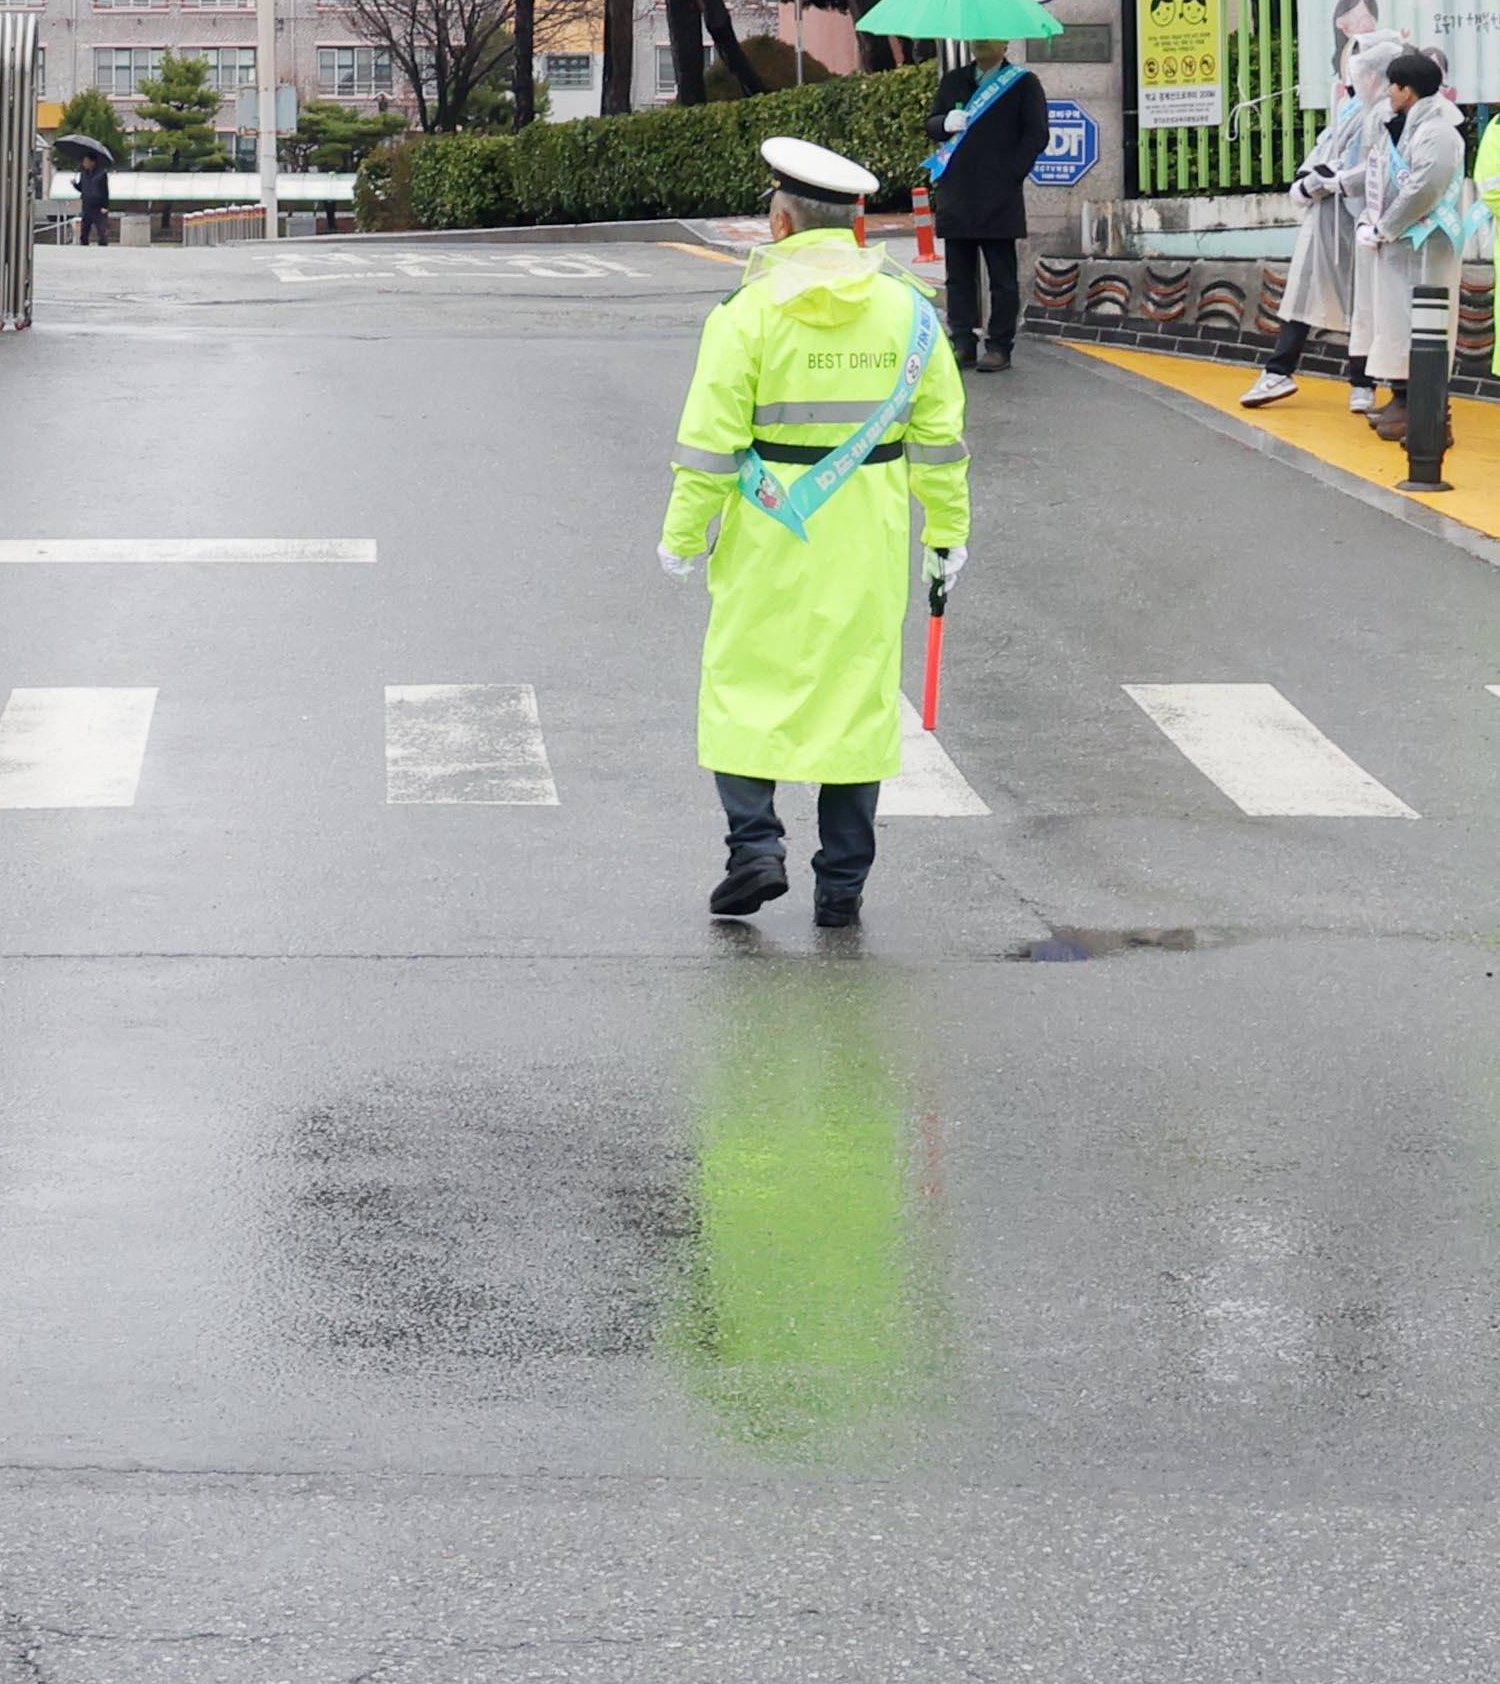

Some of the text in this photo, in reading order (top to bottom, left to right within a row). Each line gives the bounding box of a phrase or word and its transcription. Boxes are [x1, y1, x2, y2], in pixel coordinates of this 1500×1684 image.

[252, 252, 653, 282] 천천히
[808, 352, 898, 370] BEST DRIVER
